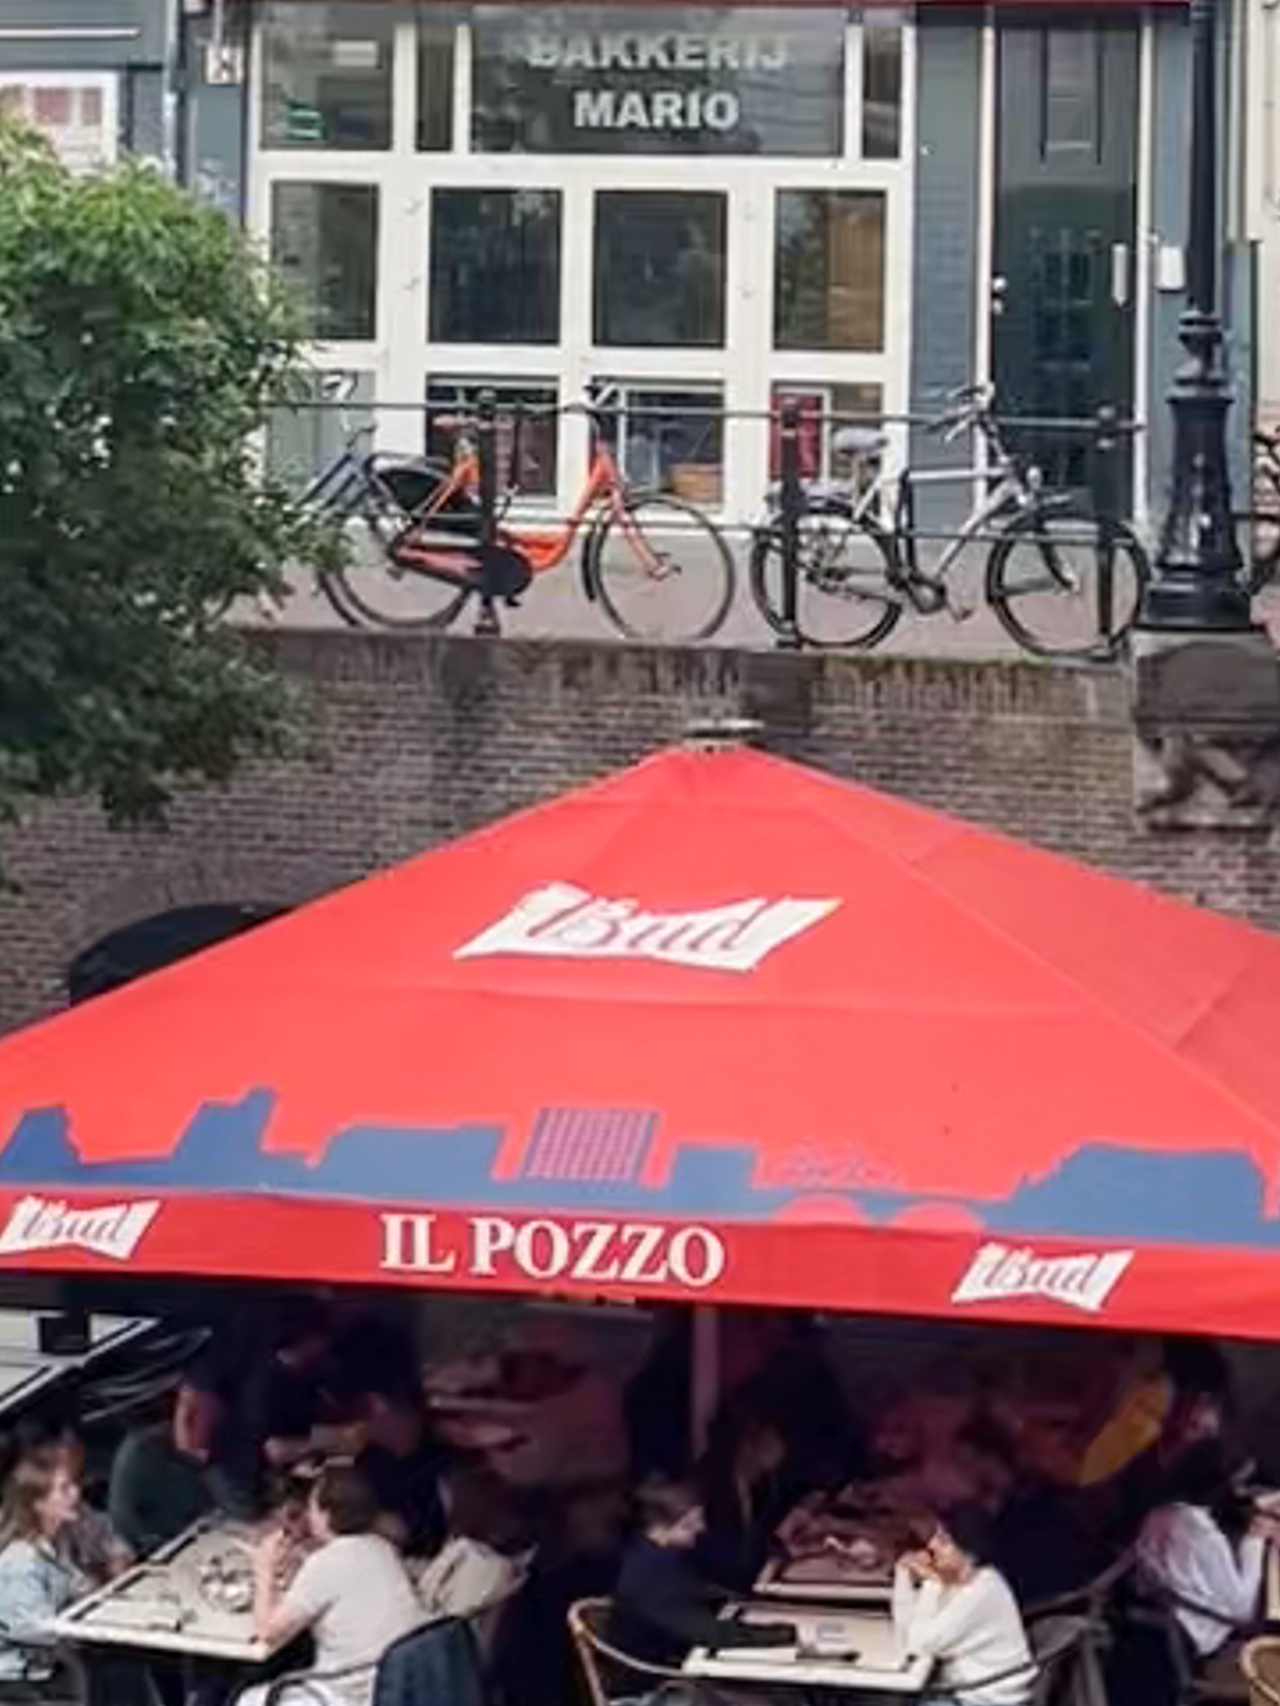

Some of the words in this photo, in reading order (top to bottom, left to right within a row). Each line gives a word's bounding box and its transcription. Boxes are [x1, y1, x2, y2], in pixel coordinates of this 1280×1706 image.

[526, 34, 788, 69] BAKKERIJ
[573, 90, 740, 130] MARIO
[521, 890, 784, 953] Bud
[21, 1199, 131, 1243] Bud
[378, 1213, 455, 1272] IL
[469, 1216, 726, 1286] POZZO
[982, 1248, 1103, 1294] Bud
